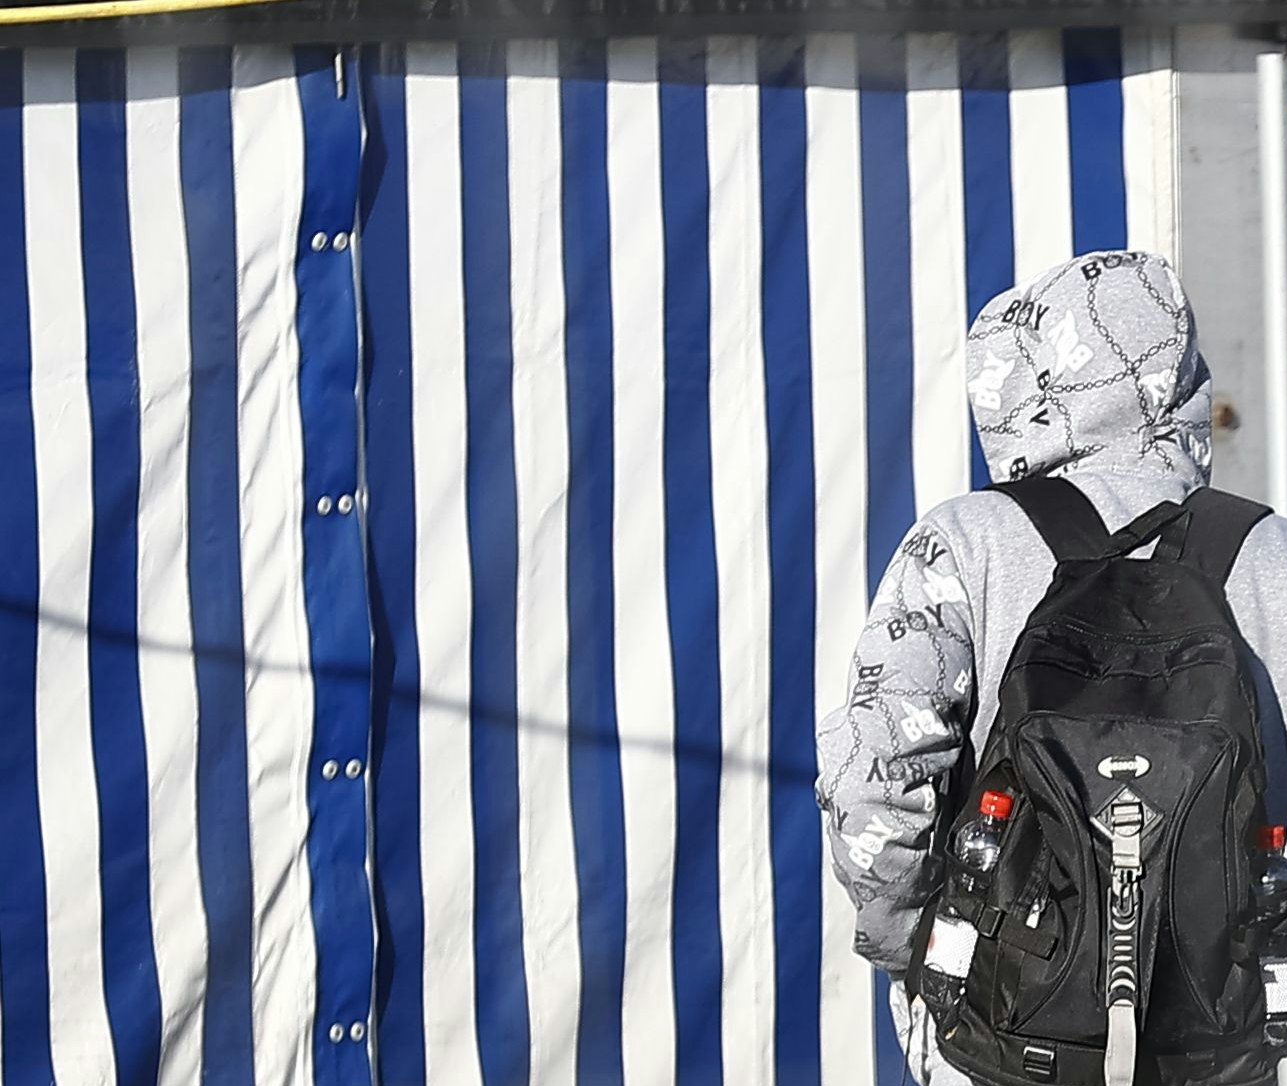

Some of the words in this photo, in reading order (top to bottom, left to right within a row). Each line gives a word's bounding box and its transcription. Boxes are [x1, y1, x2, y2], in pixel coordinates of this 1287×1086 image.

[1081, 253, 1138, 281] BO
[1002, 299, 1050, 331] BOY
[887, 603, 945, 642] BOY
[852, 663, 884, 712] BOY
[848, 814, 895, 871] BOY
